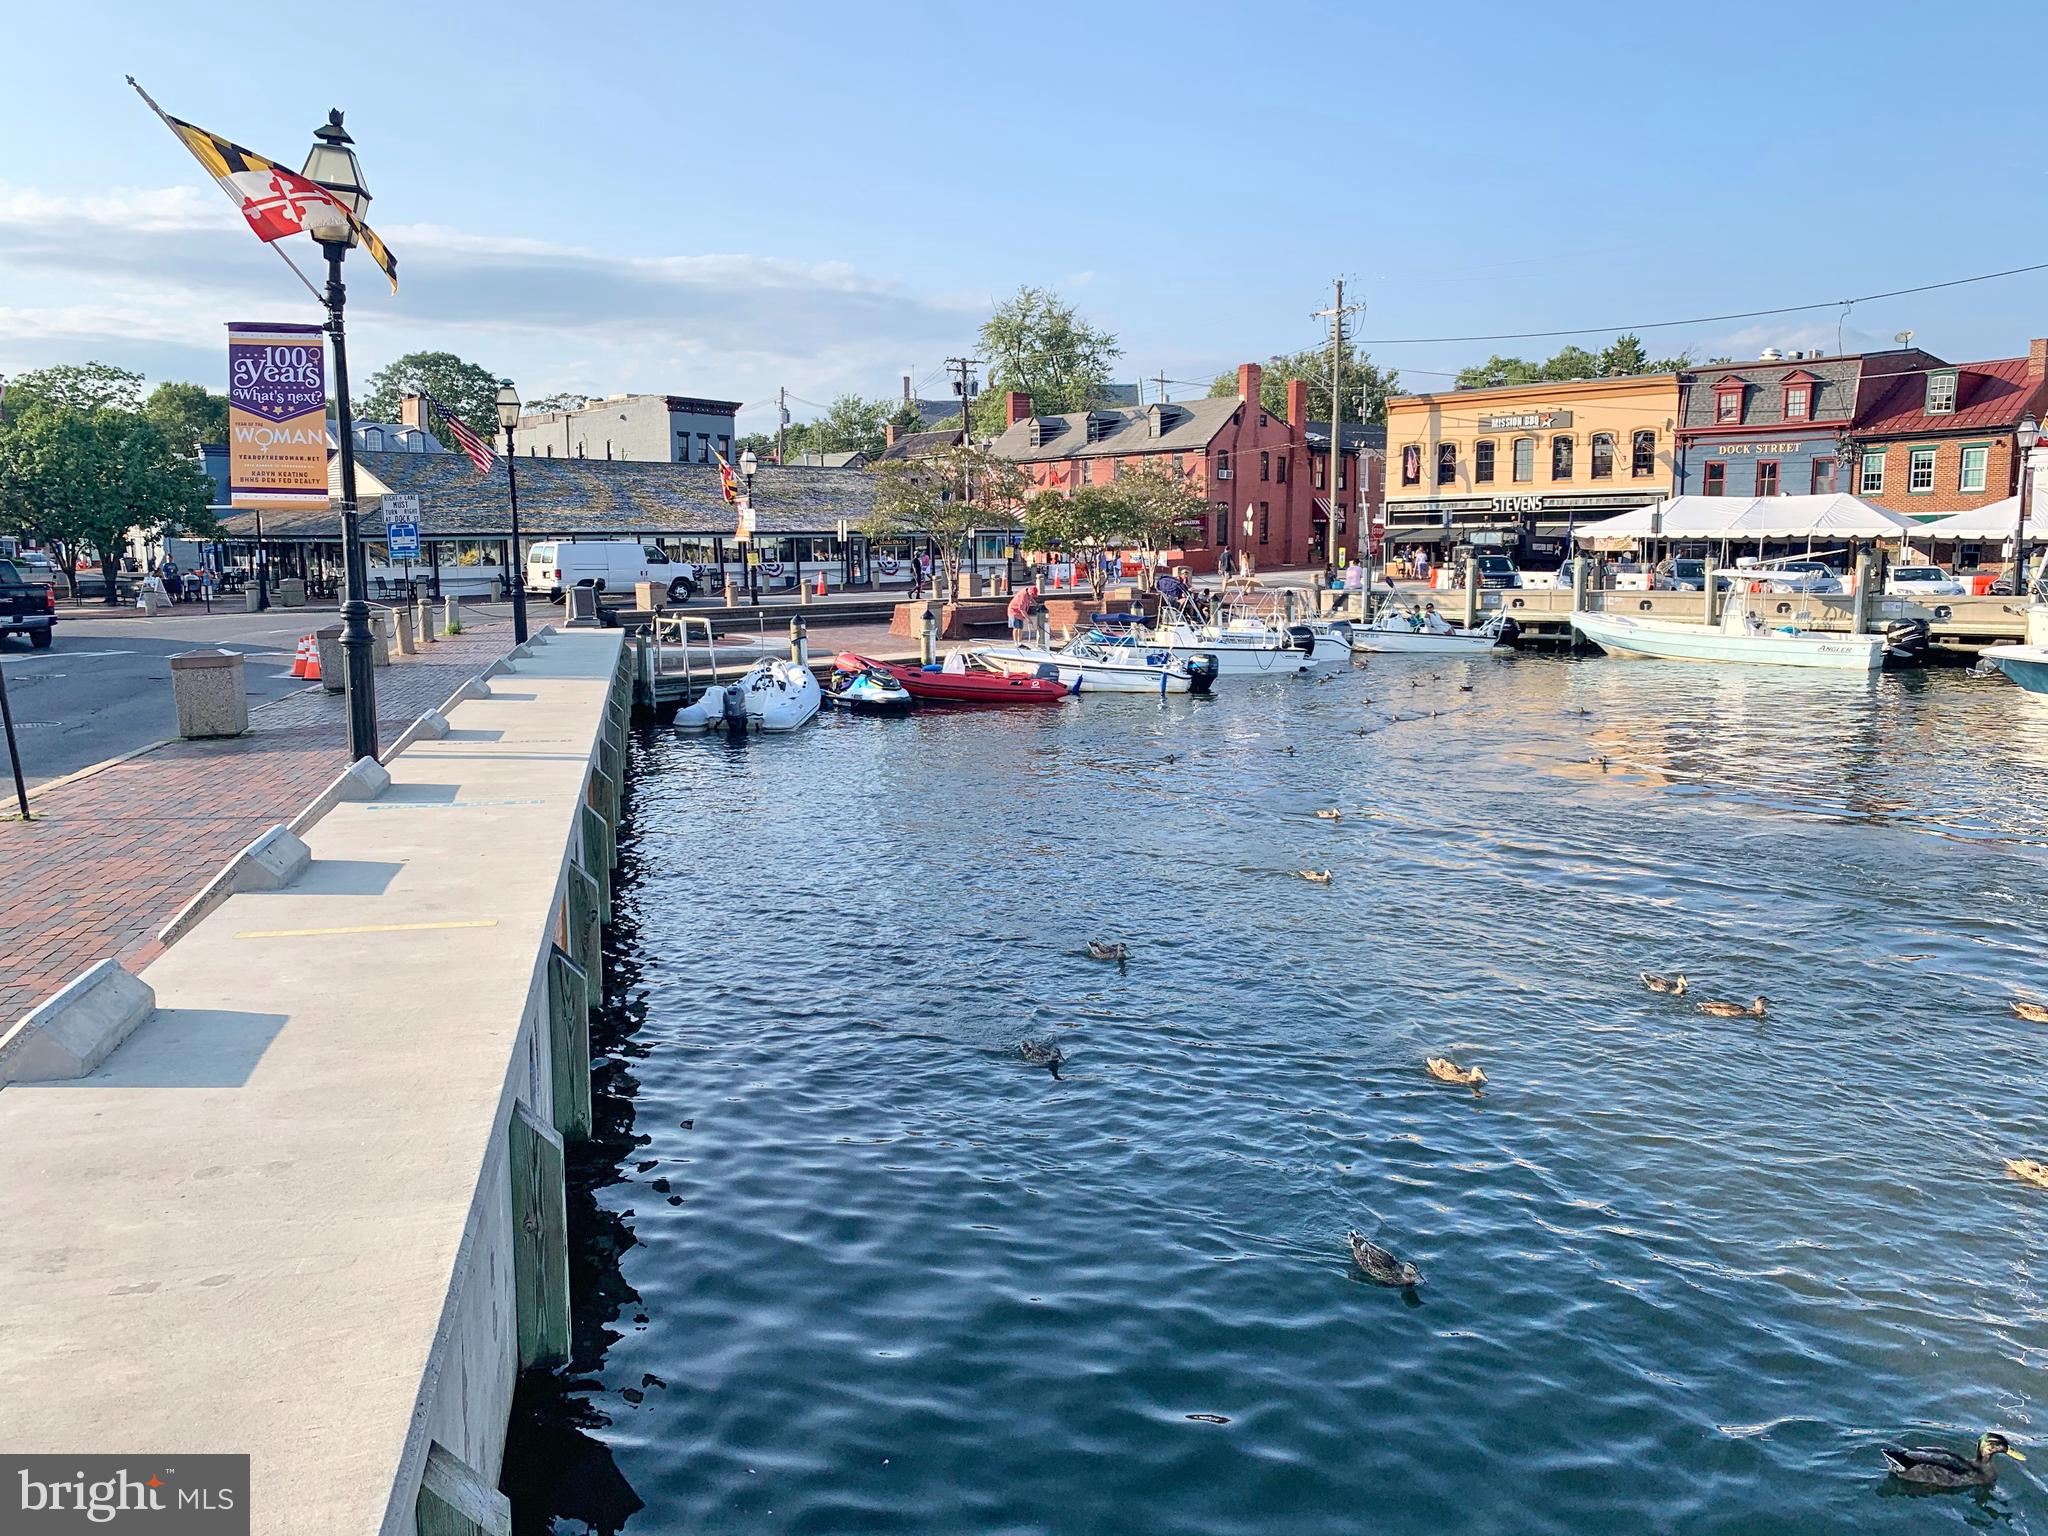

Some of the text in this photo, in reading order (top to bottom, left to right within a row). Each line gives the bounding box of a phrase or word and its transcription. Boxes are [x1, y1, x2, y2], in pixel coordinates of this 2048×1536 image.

[264, 347, 307, 367] 100
[234, 359, 320, 388] Years
[233, 387, 322, 404] What's next?
[1491, 415, 1539, 428] MISSION BBQ
[235, 427, 322, 452] WOMAN
[1719, 443, 1801, 455] DOCK STREET
[239, 454, 320, 462] YEAROFTHEWOMAN.NET
[1492, 496, 1543, 511] STEVENS
